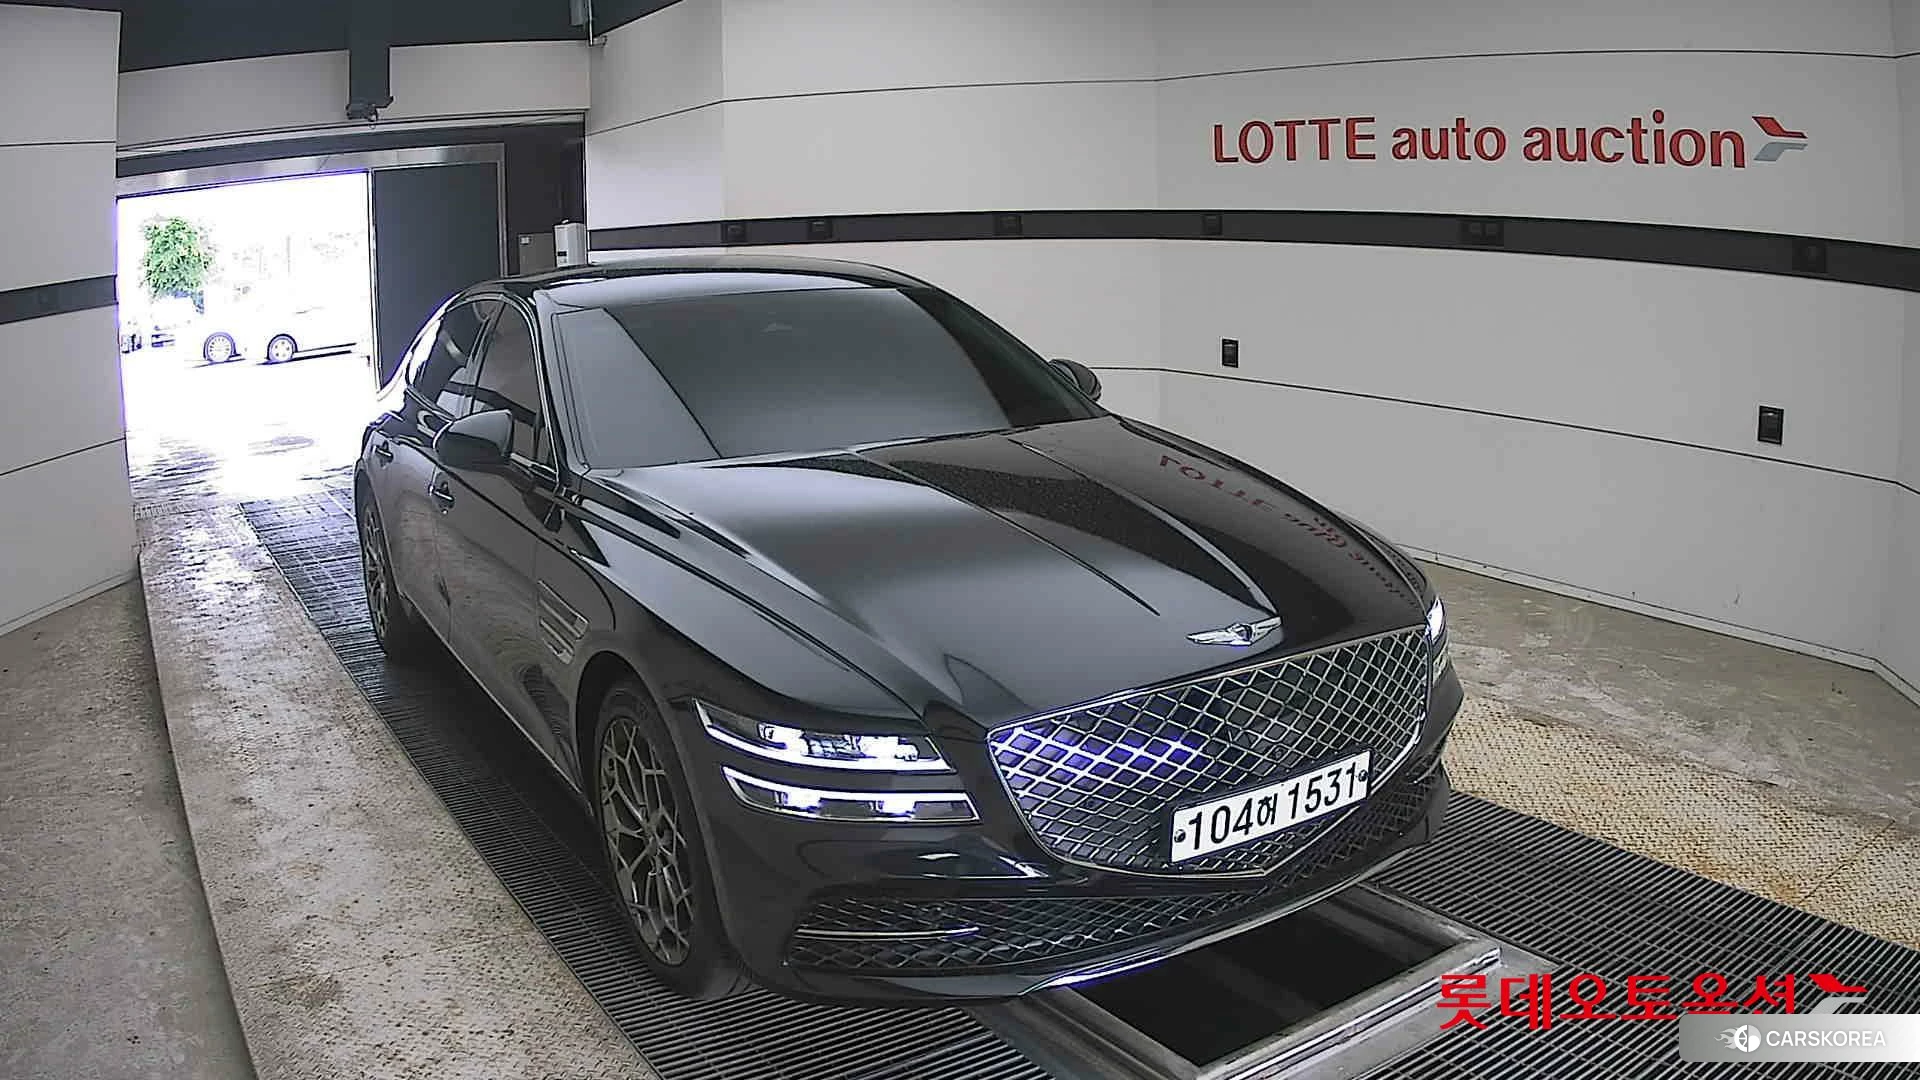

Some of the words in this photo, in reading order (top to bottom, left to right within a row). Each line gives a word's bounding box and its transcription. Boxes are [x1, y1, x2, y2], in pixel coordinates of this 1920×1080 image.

[1213, 116, 1376, 163] LOTTE
[1392, 117, 1506, 161] auto
[1522, 109, 1746, 168] auction
[1188, 793, 1278, 850] 104허
[1288, 762, 1357, 820] 1531
